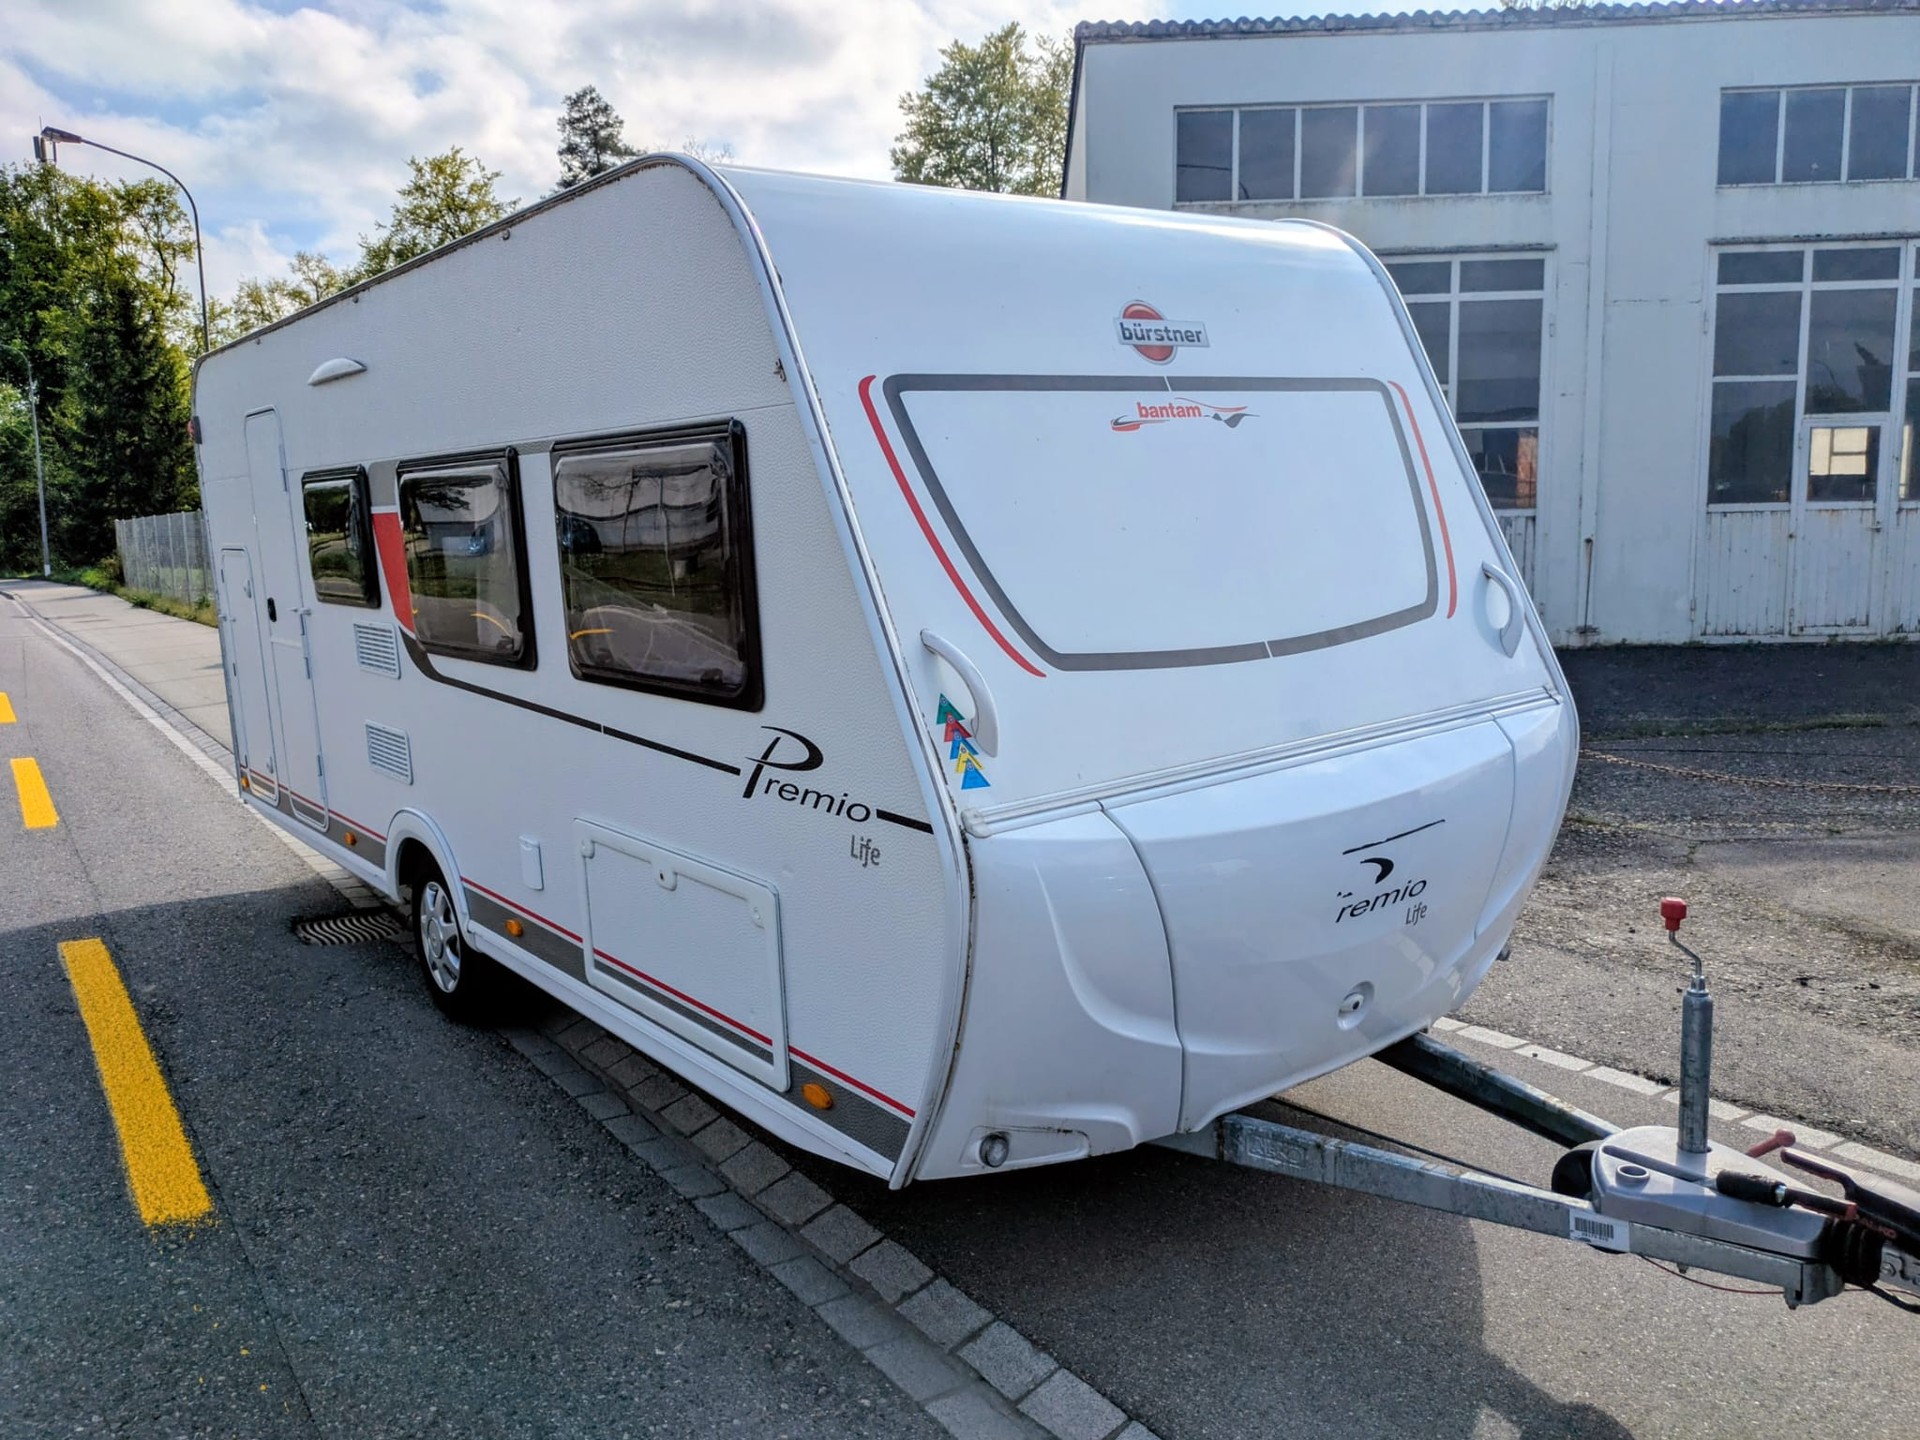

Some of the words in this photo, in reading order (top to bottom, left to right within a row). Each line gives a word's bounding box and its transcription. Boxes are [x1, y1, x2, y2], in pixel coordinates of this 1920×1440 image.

[1119, 321, 1202, 343] bürstner
[1136, 401, 1202, 418] bantam
[743, 725, 871, 822] Premio
[850, 834, 881, 867] Life
[1405, 901, 1428, 925] Life
